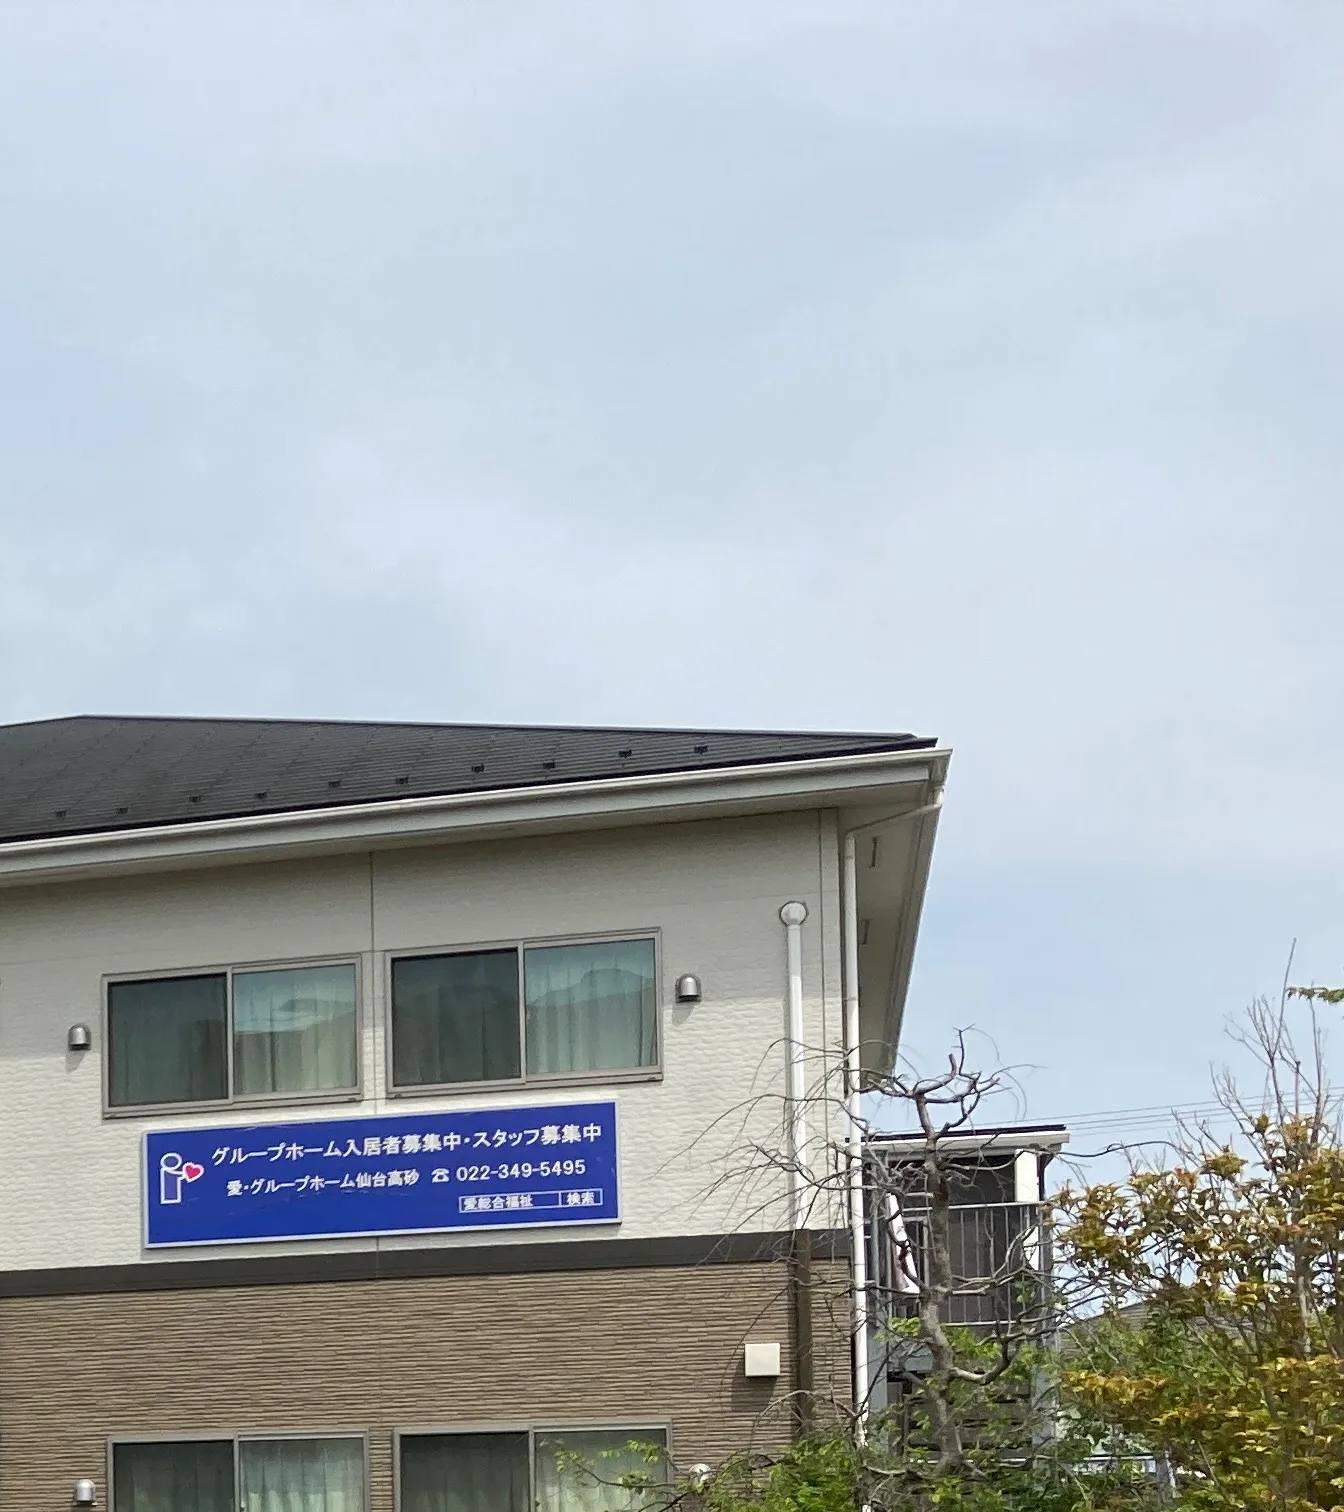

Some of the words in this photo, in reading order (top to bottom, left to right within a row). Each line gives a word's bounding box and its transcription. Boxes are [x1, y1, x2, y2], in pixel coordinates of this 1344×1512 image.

[212, 1123, 602, 1165] グループホーム入居者募集中・スタッフ募集中
[456, 1159, 586, 1181] 022-349-5495
